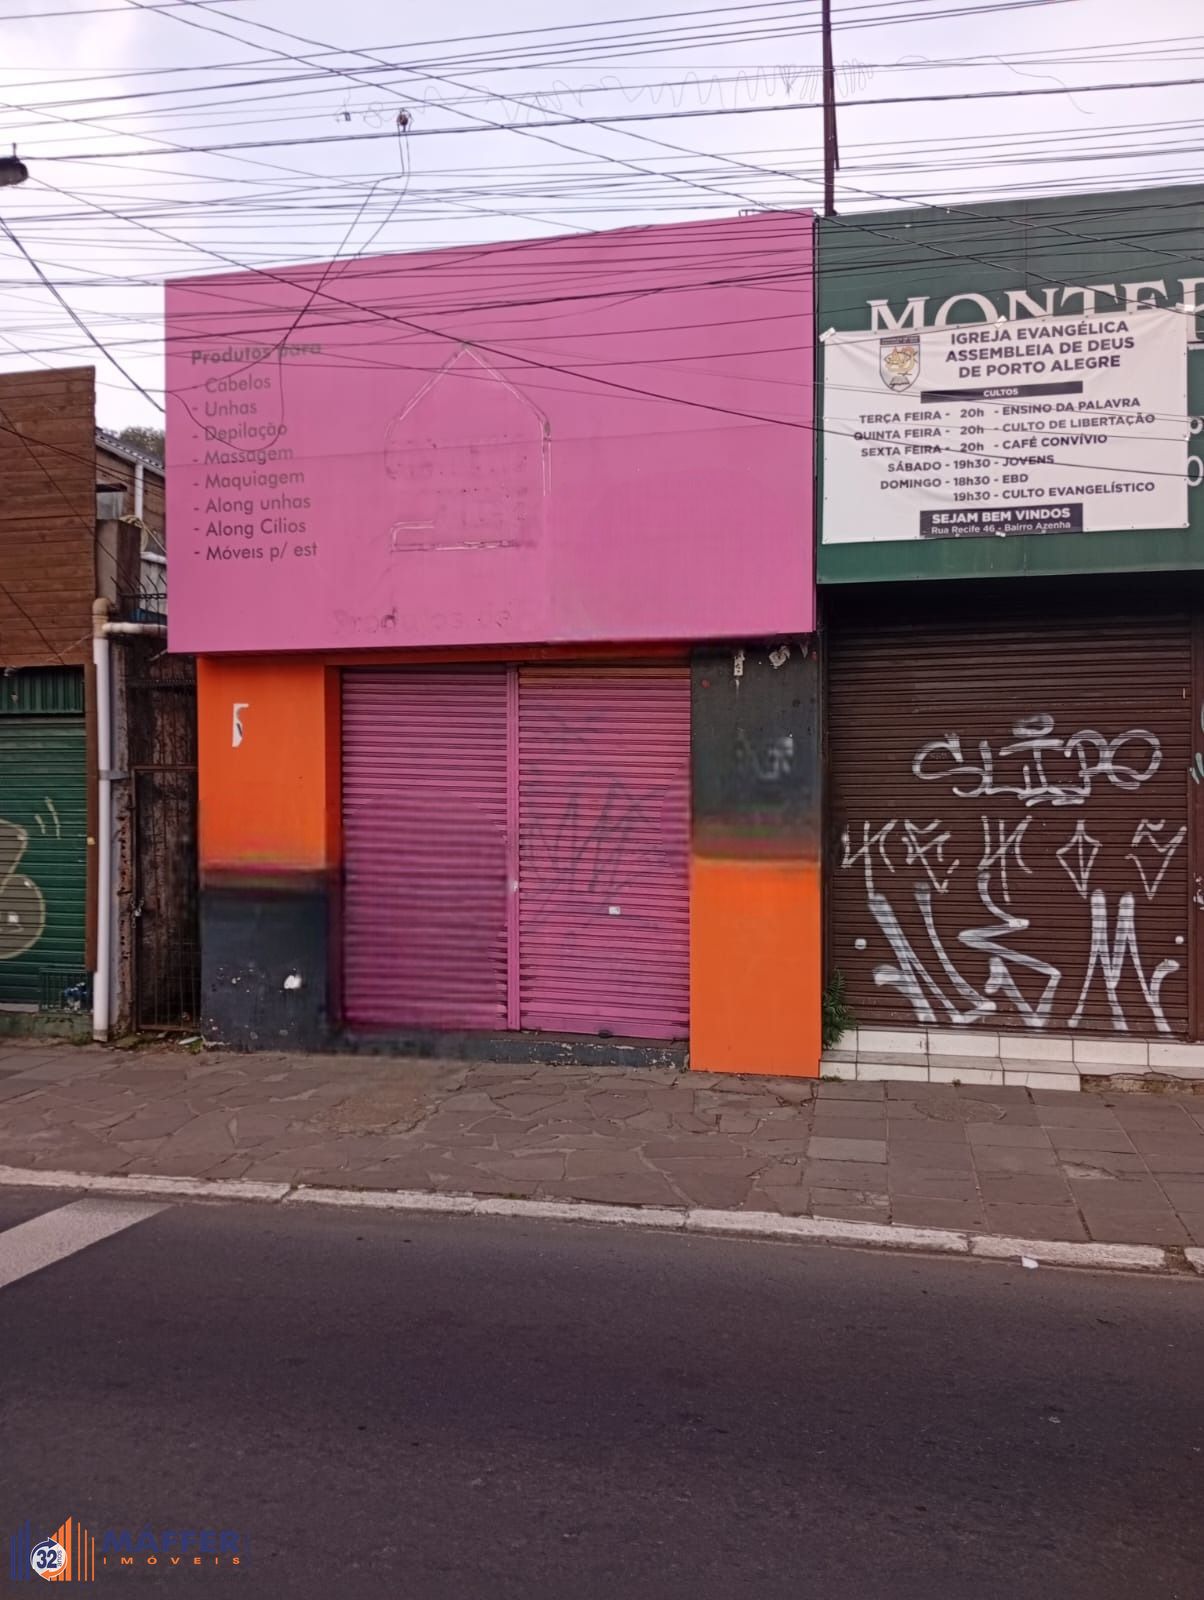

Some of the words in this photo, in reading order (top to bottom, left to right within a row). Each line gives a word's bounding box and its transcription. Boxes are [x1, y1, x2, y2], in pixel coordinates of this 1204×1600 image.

[951, 329, 1012, 345] IGREJA
[1017, 321, 1129, 340] EVANGÉLICA
[191, 346, 271, 365] Produtos
[946, 343, 1054, 362] ASSEMBLEIA
[1060, 341, 1083, 354] DE
[1088, 337, 1135, 352] DEUS
[959, 366, 981, 378] DE
[986, 361, 1045, 377] PORTO
[1051, 355, 1121, 372] ALEGRE
[205, 373, 271, 393] Cabelos
[983, 388, 1019, 398] CULTOS
[204, 400, 257, 417] Unhas
[860, 413, 901, 424] TERÇA
[904, 411, 942, 421] FEIRA
[960, 408, 984, 418] 20h
[1002, 403, 1052, 415] ENSINO
[1056, 402, 1074, 412] DA
[1078, 398, 1141, 410] PALAVRA
[204, 421, 288, 443] Depilação
[854, 430, 901, 441] QUINTA
[904, 428, 942, 438] FEIRA
[960, 425, 984, 435] 20h
[1002, 421, 1045, 432] CULTO
[1049, 420, 1067, 429] DE
[1070, 412, 1156, 428] LIBERTAÇÃO
[861, 446, 901, 457] SEXTA
[904, 445, 942, 455] FEIRA
[960, 442, 984, 452] 20h
[1002, 436, 1037, 449] CAFÉ
[1041, 433, 1108, 447] CONVÍVIO
[204, 447, 294, 465] Massagem
[887, 460, 942, 472] SÁBADO
[953, 459, 991, 469] 19h30
[1002, 455, 1055, 467] JOVENS
[205, 470, 304, 491] Maquiagem
[880, 479, 942, 490] DOMINGO
[953, 476, 990, 486] 18h30
[1002, 474, 1029, 484] EBD
[953, 491, 991, 502] 19h30
[1002, 488, 1045, 499] CULTO
[1049, 481, 1155, 497] EVANGELÍSTICO
[205, 496, 254, 516] Along
[260, 493, 311, 510] unhas
[932, 512, 978, 524] SEJAM
[982, 510, 1012, 522] BEM
[1015, 507, 1071, 520] VINDOS
[205, 521, 254, 539] Along
[931, 526, 949, 535] Rua
[952, 525, 980, 535] Recife
[982, 524, 995, 533] 46
[1004, 523, 1033, 532] Bairro
[1035, 521, 1071, 531] Azenha
[206, 544, 264, 561] Móveis
[270, 541, 288, 562] p/
[294, 541, 318, 557] est
